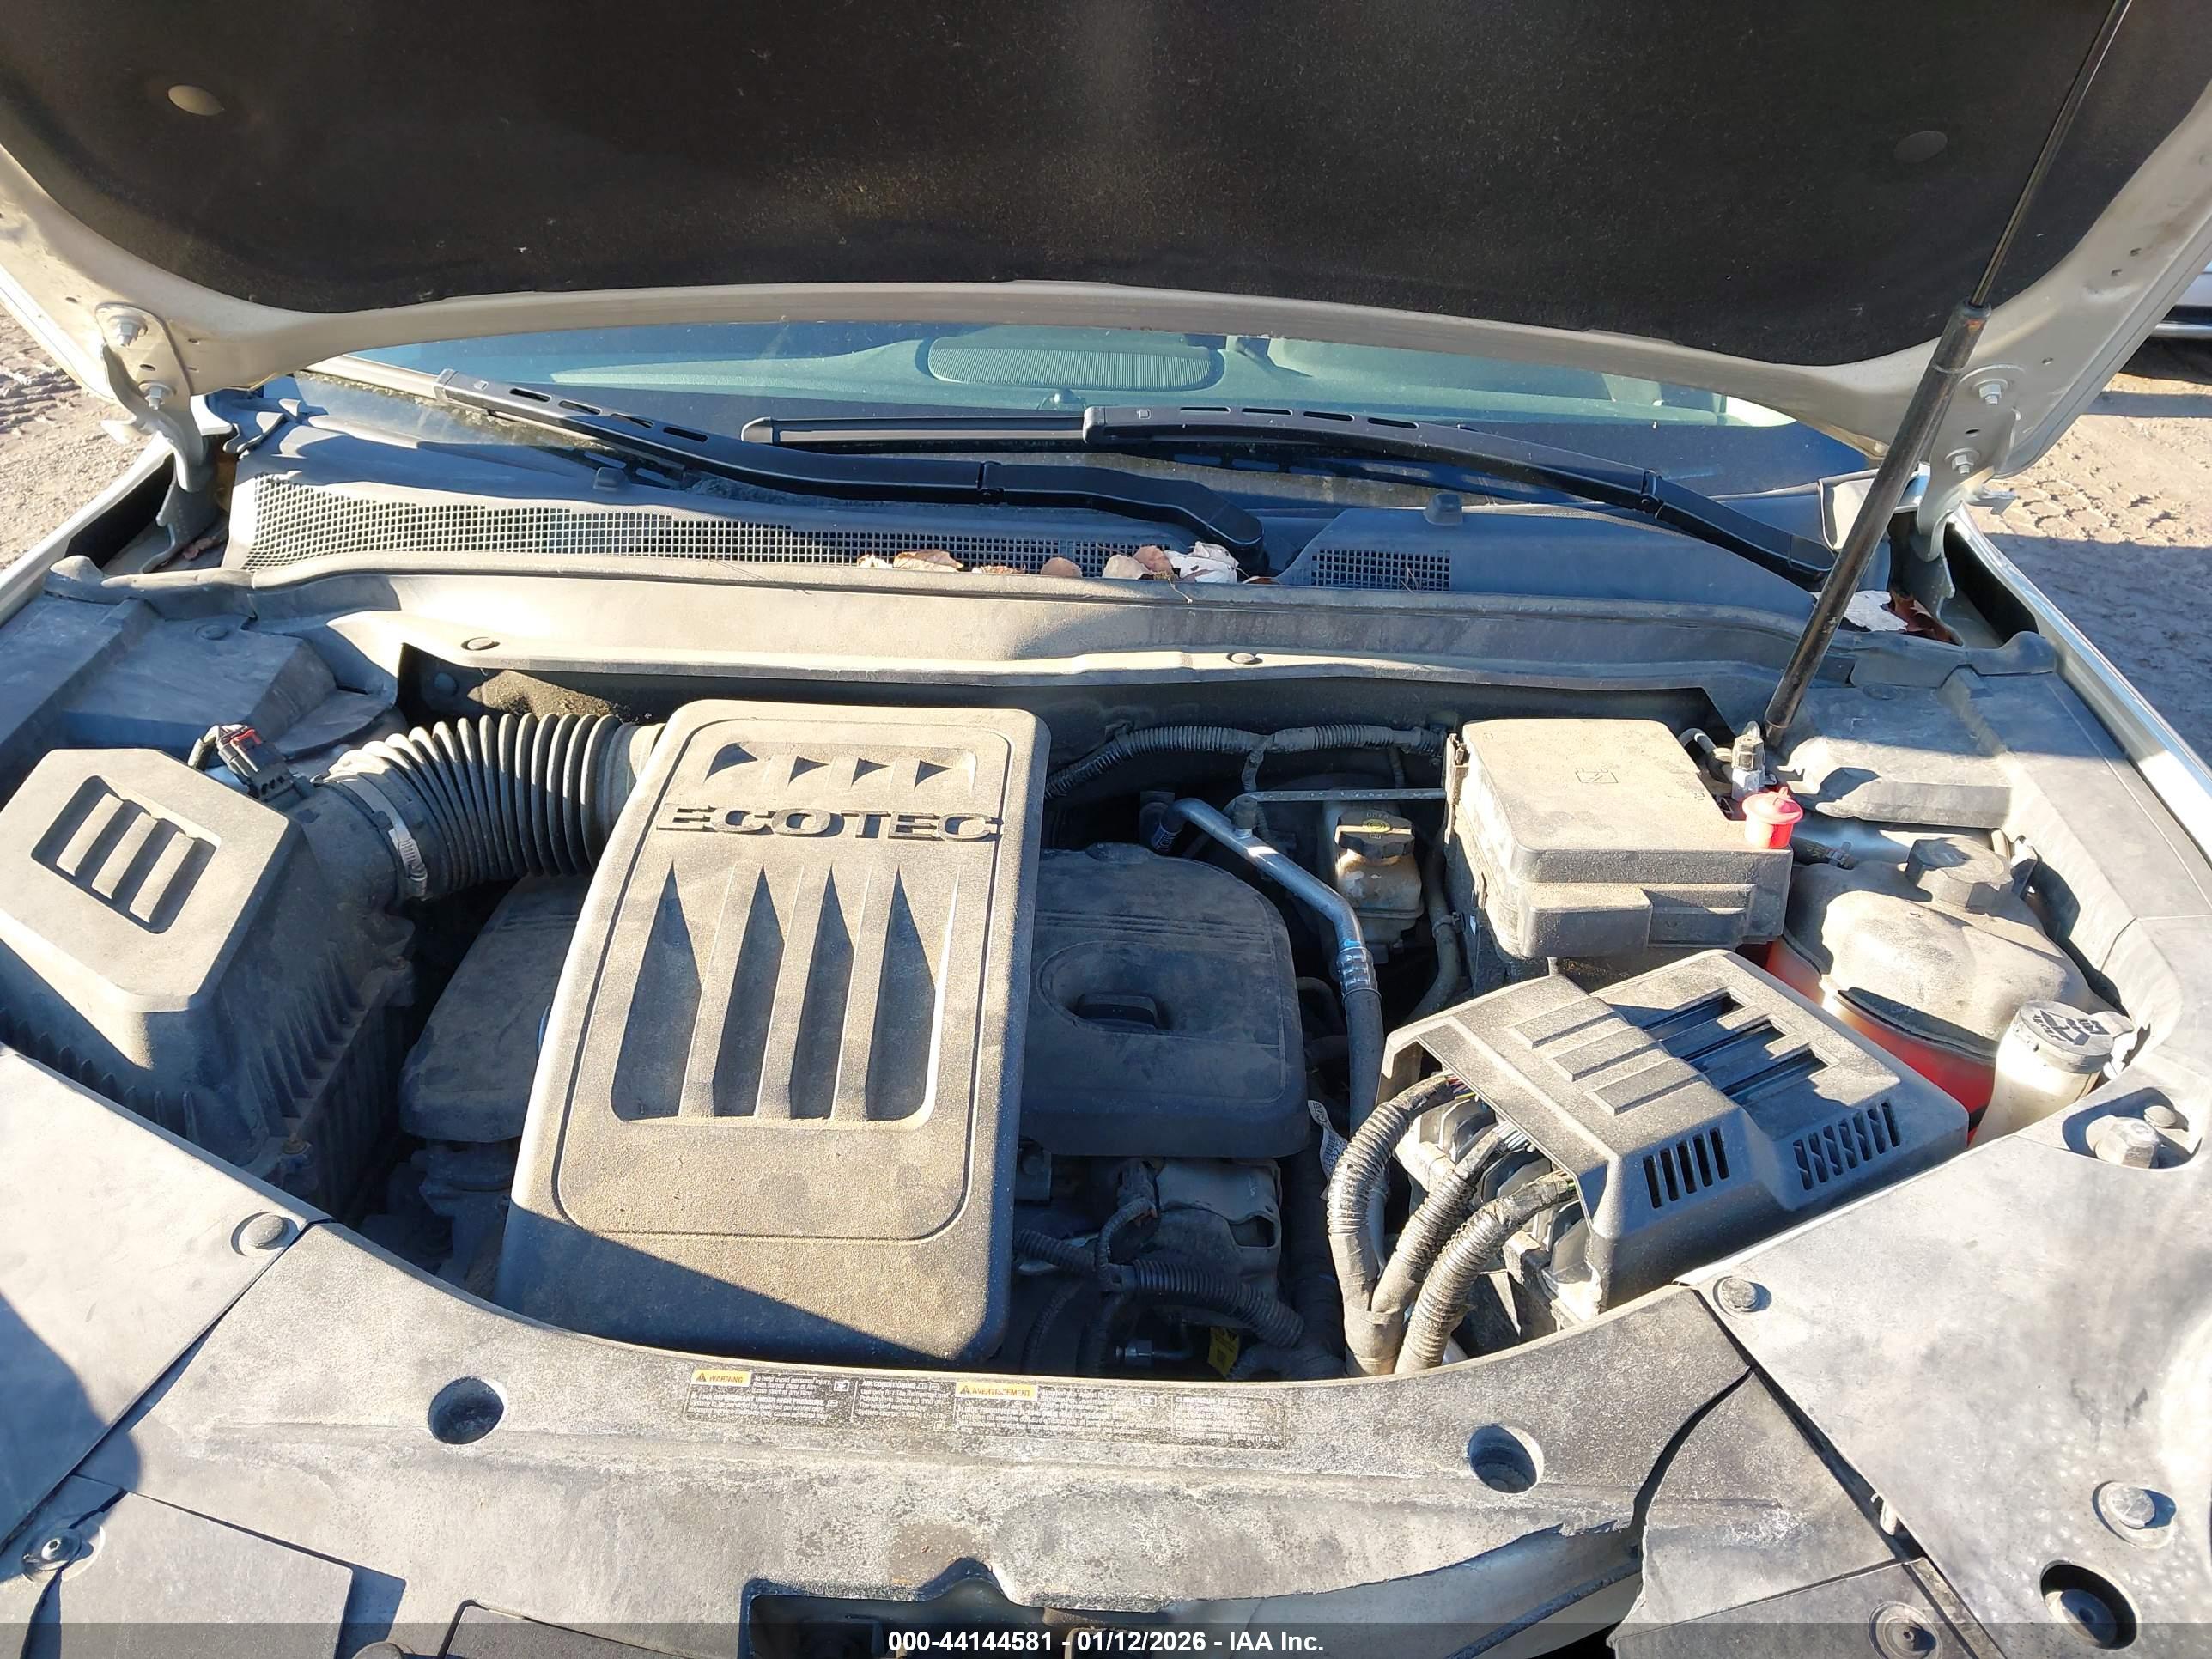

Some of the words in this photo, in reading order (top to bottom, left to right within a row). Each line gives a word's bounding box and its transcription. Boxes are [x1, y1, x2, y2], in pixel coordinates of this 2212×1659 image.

[656, 803, 1001, 841] ECOTEC
[709, 1375, 744, 1383] WARNING
[972, 1387, 1031, 1397] AVERTISSEMENT
